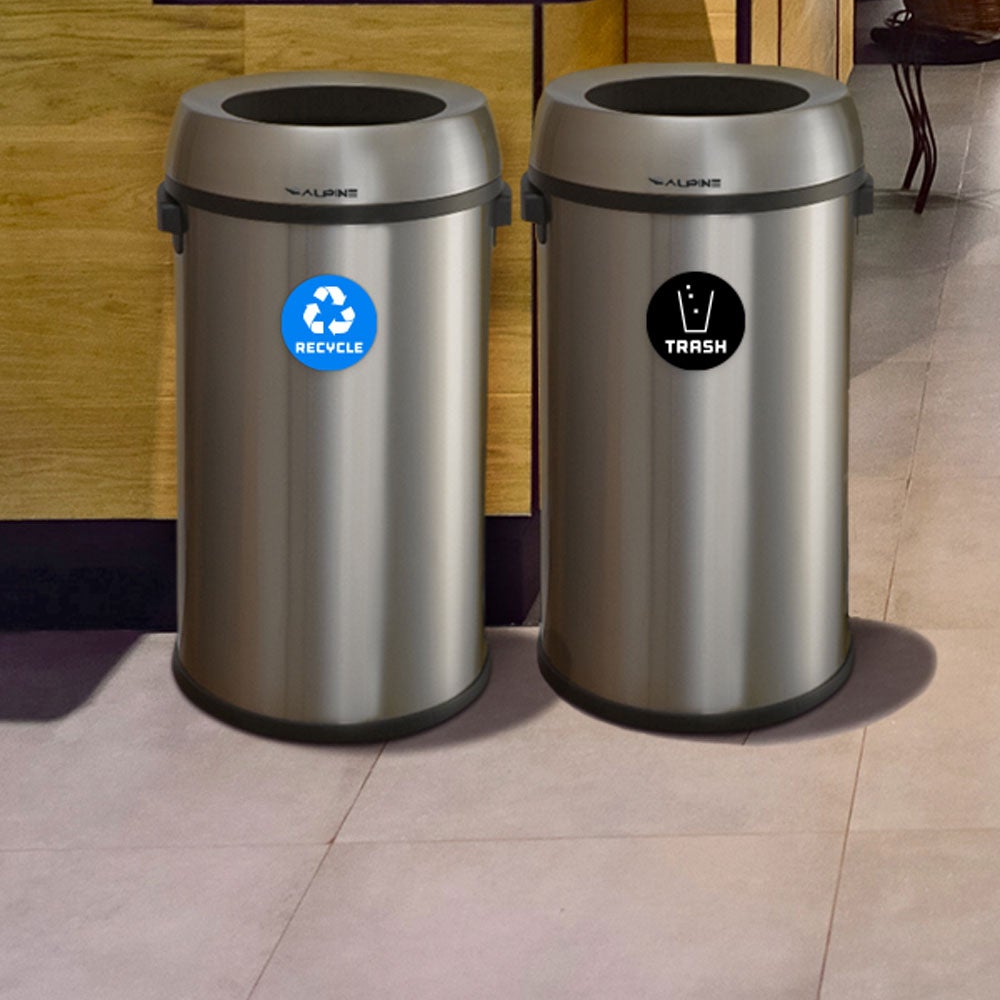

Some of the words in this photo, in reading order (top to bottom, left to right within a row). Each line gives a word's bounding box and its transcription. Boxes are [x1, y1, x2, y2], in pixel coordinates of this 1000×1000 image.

[665, 179, 721, 188] ALPINE
[302, 188, 358, 198] ALPINE
[295, 342, 363, 354] RECYCLE
[664, 340, 727, 354] TRASH
